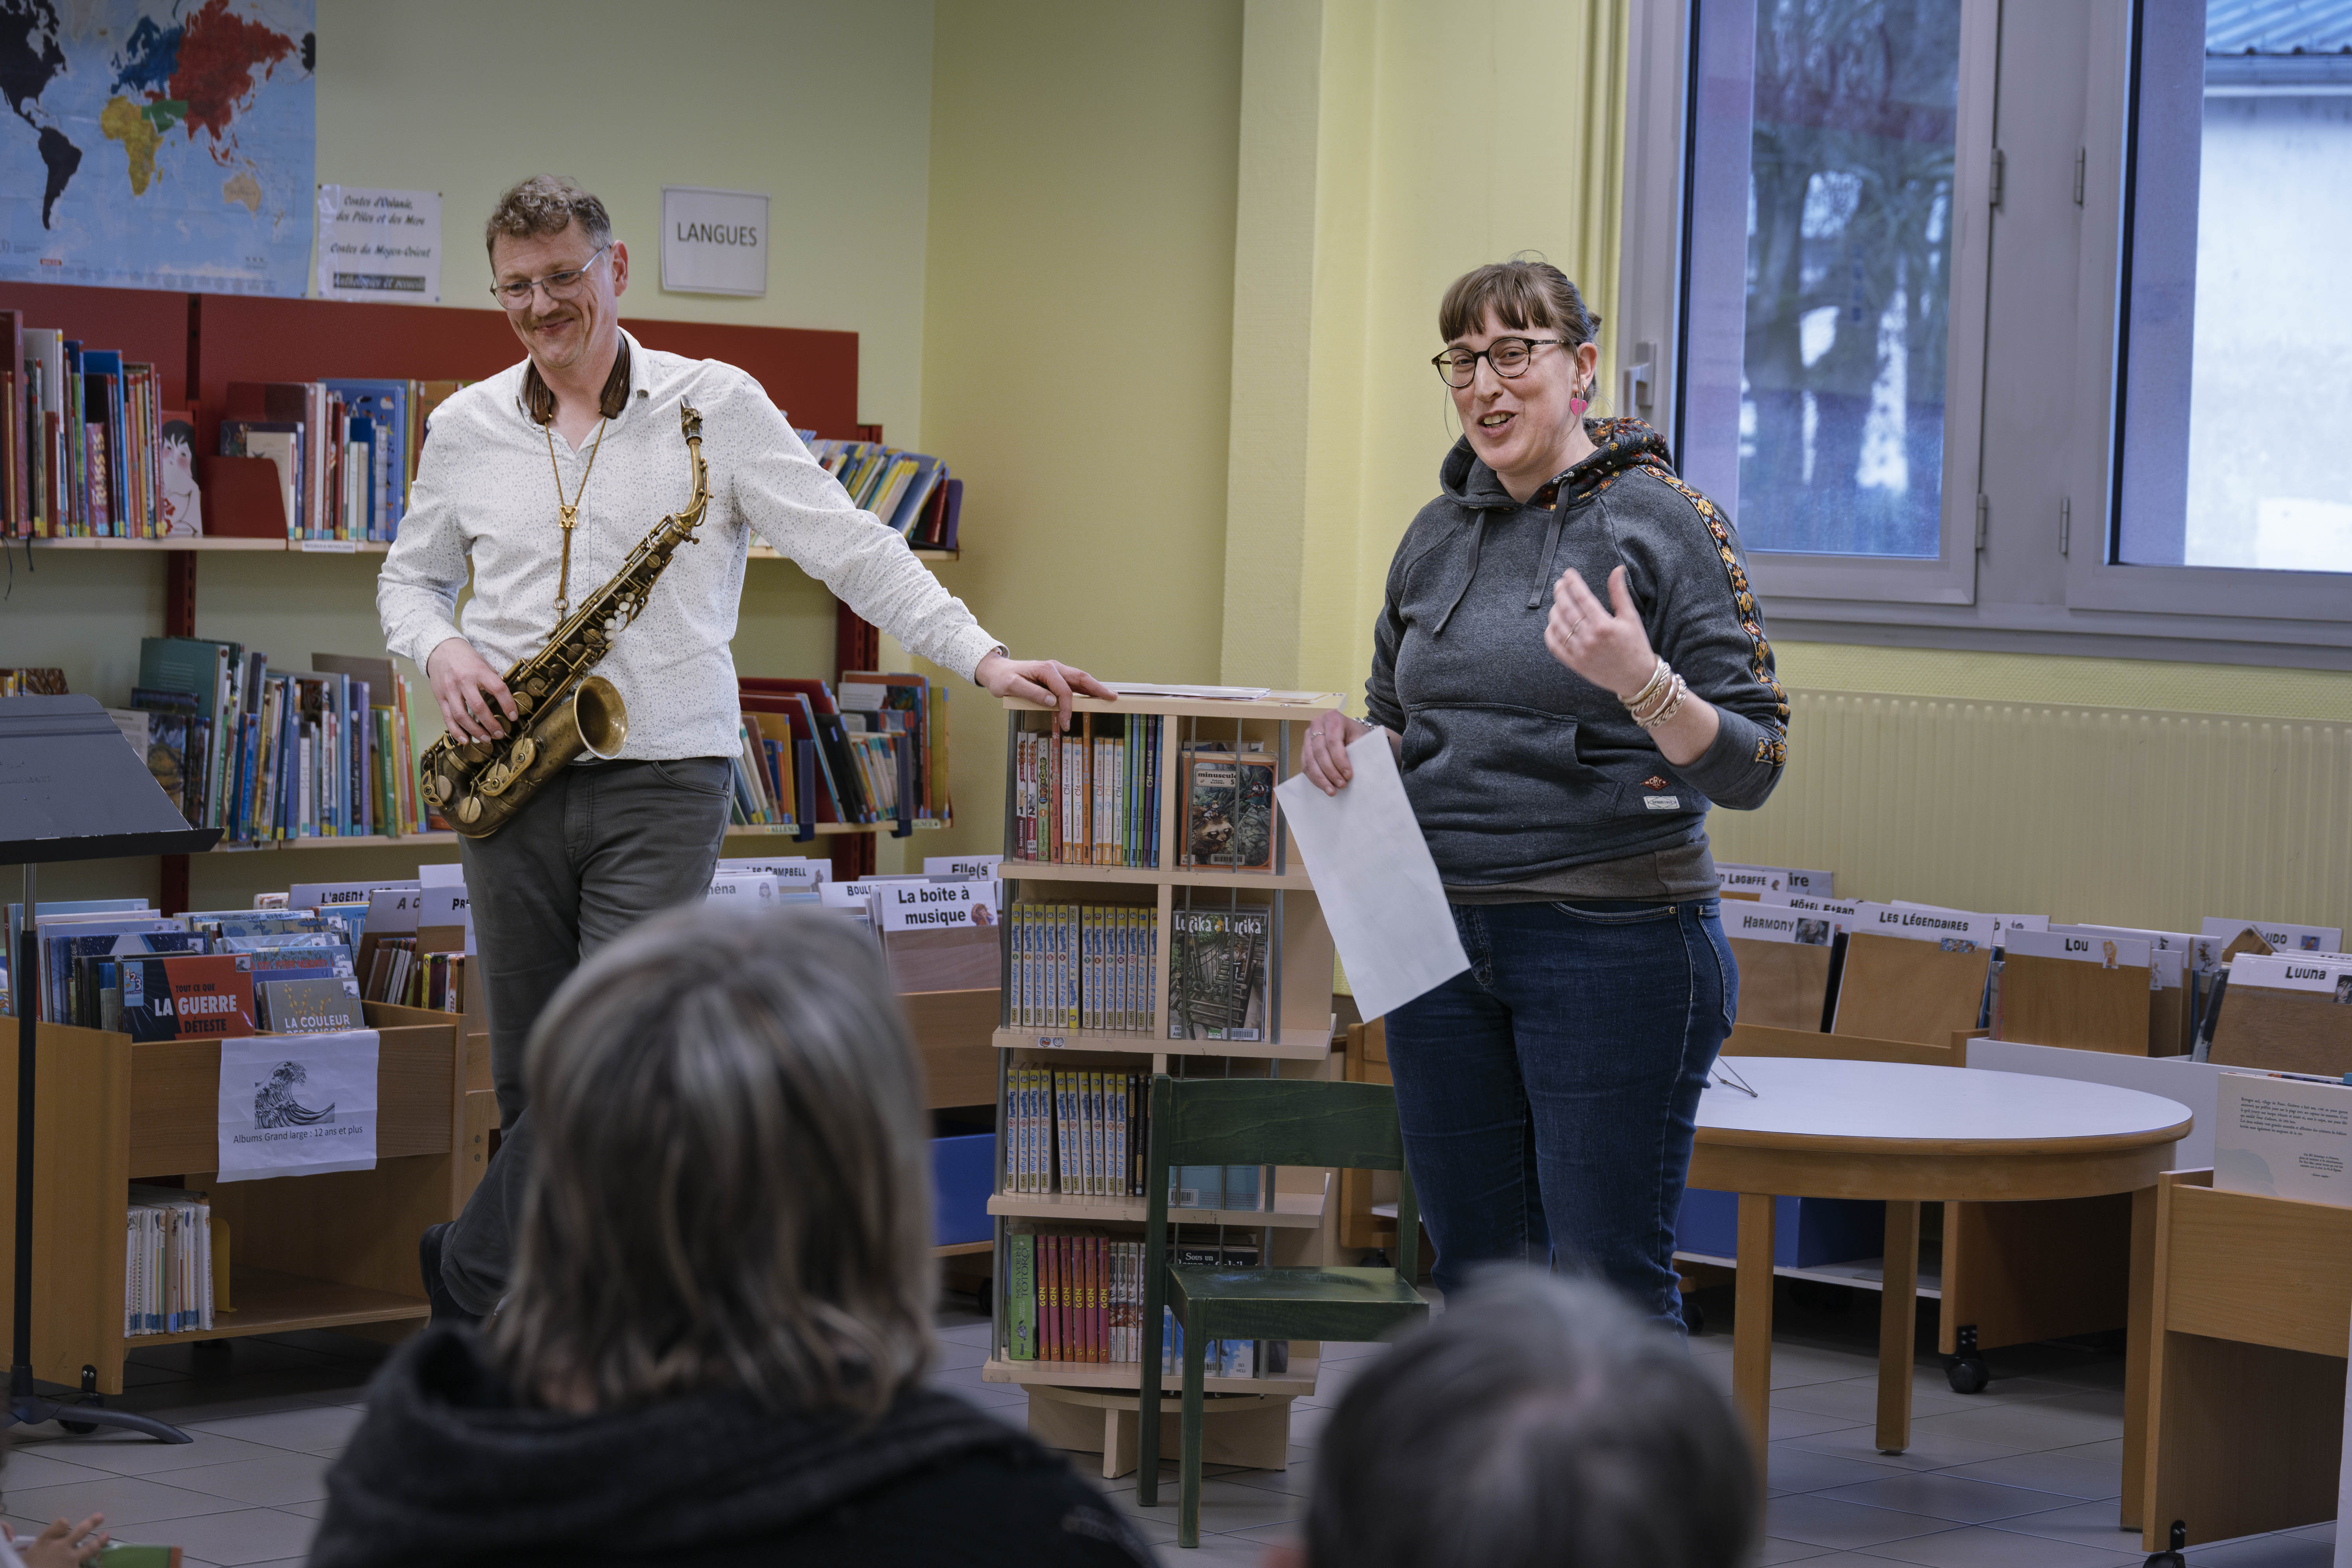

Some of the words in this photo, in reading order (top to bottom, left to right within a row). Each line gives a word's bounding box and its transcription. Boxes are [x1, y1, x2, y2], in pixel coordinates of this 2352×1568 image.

[376, 213, 386, 223] et
[677, 221, 757, 247] LANGUES
[331, 243, 357, 253] Contes
[1649, 777, 1662, 786] DRY
[1019, 806, 1024, 815] 1
[1029, 807, 1035, 815] 2
[1063, 801, 1070, 809] 4
[1105, 802, 1111, 811] 9
[1789, 872, 1809, 887] ire
[848, 886, 871, 896] Boul
[898, 889, 916, 904] La
[920, 887, 956, 902] boîte
[961, 886, 970, 900] à
[905, 909, 966, 926] musique
[154, 998, 173, 1016] LA
[178, 995, 237, 1015] GUERRE
[184, 1016, 227, 1033] DÉTESTE
[285, 1017, 298, 1029] LA
[300, 1014, 350, 1028] COULEUR
[233, 1134, 262, 1143] Albums
[265, 1131, 288, 1141] Grand
[290, 1130, 308, 1140] large
[348, 1125, 363, 1136] plus
[1185, 1252, 1203, 1261] Sous
[1021, 1247, 1030, 1298] TOTORO
